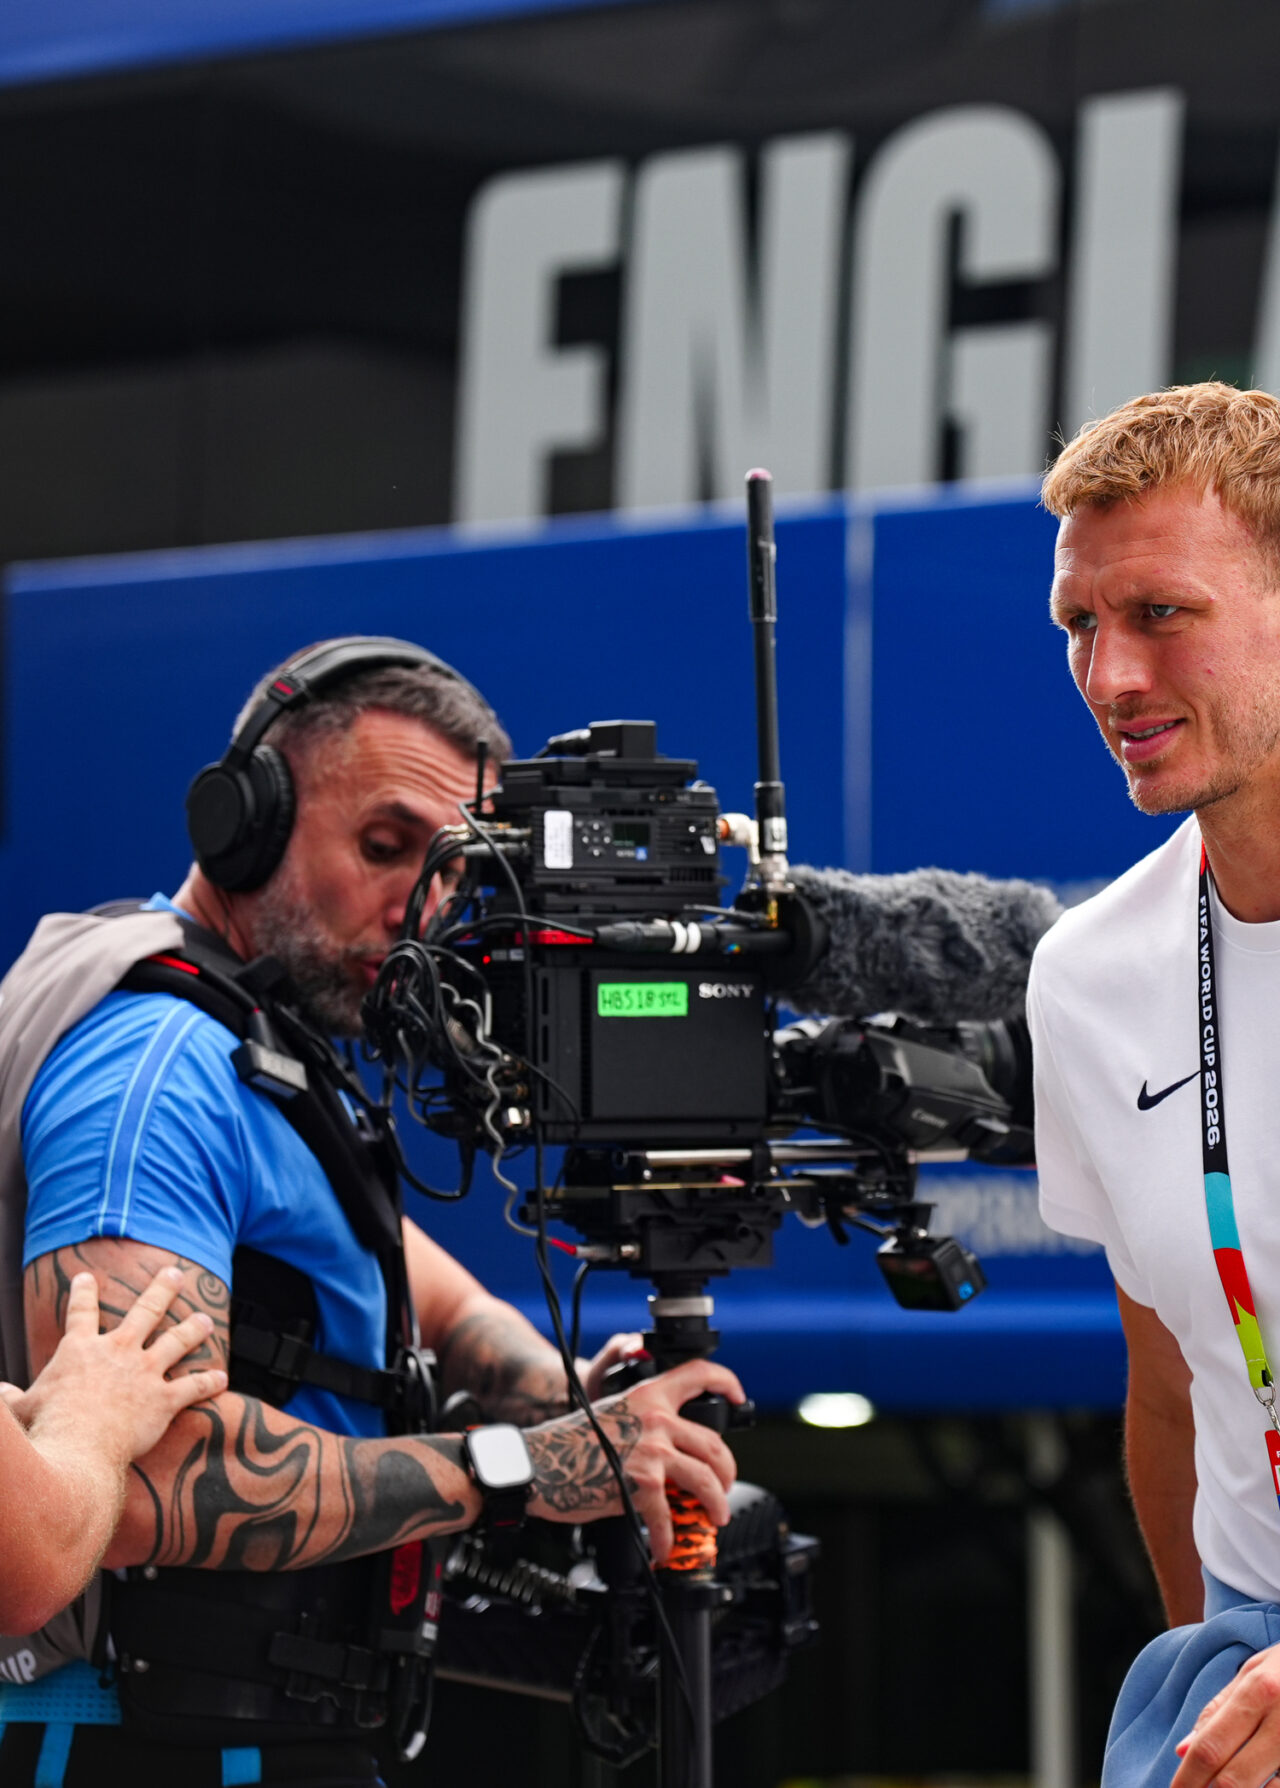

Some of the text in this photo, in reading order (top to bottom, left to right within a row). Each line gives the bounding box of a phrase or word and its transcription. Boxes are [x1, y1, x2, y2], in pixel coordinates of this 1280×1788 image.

[699, 982, 754, 999] SONY
[1199, 895, 1221, 1145] FIFA WORLD CUP 2026
